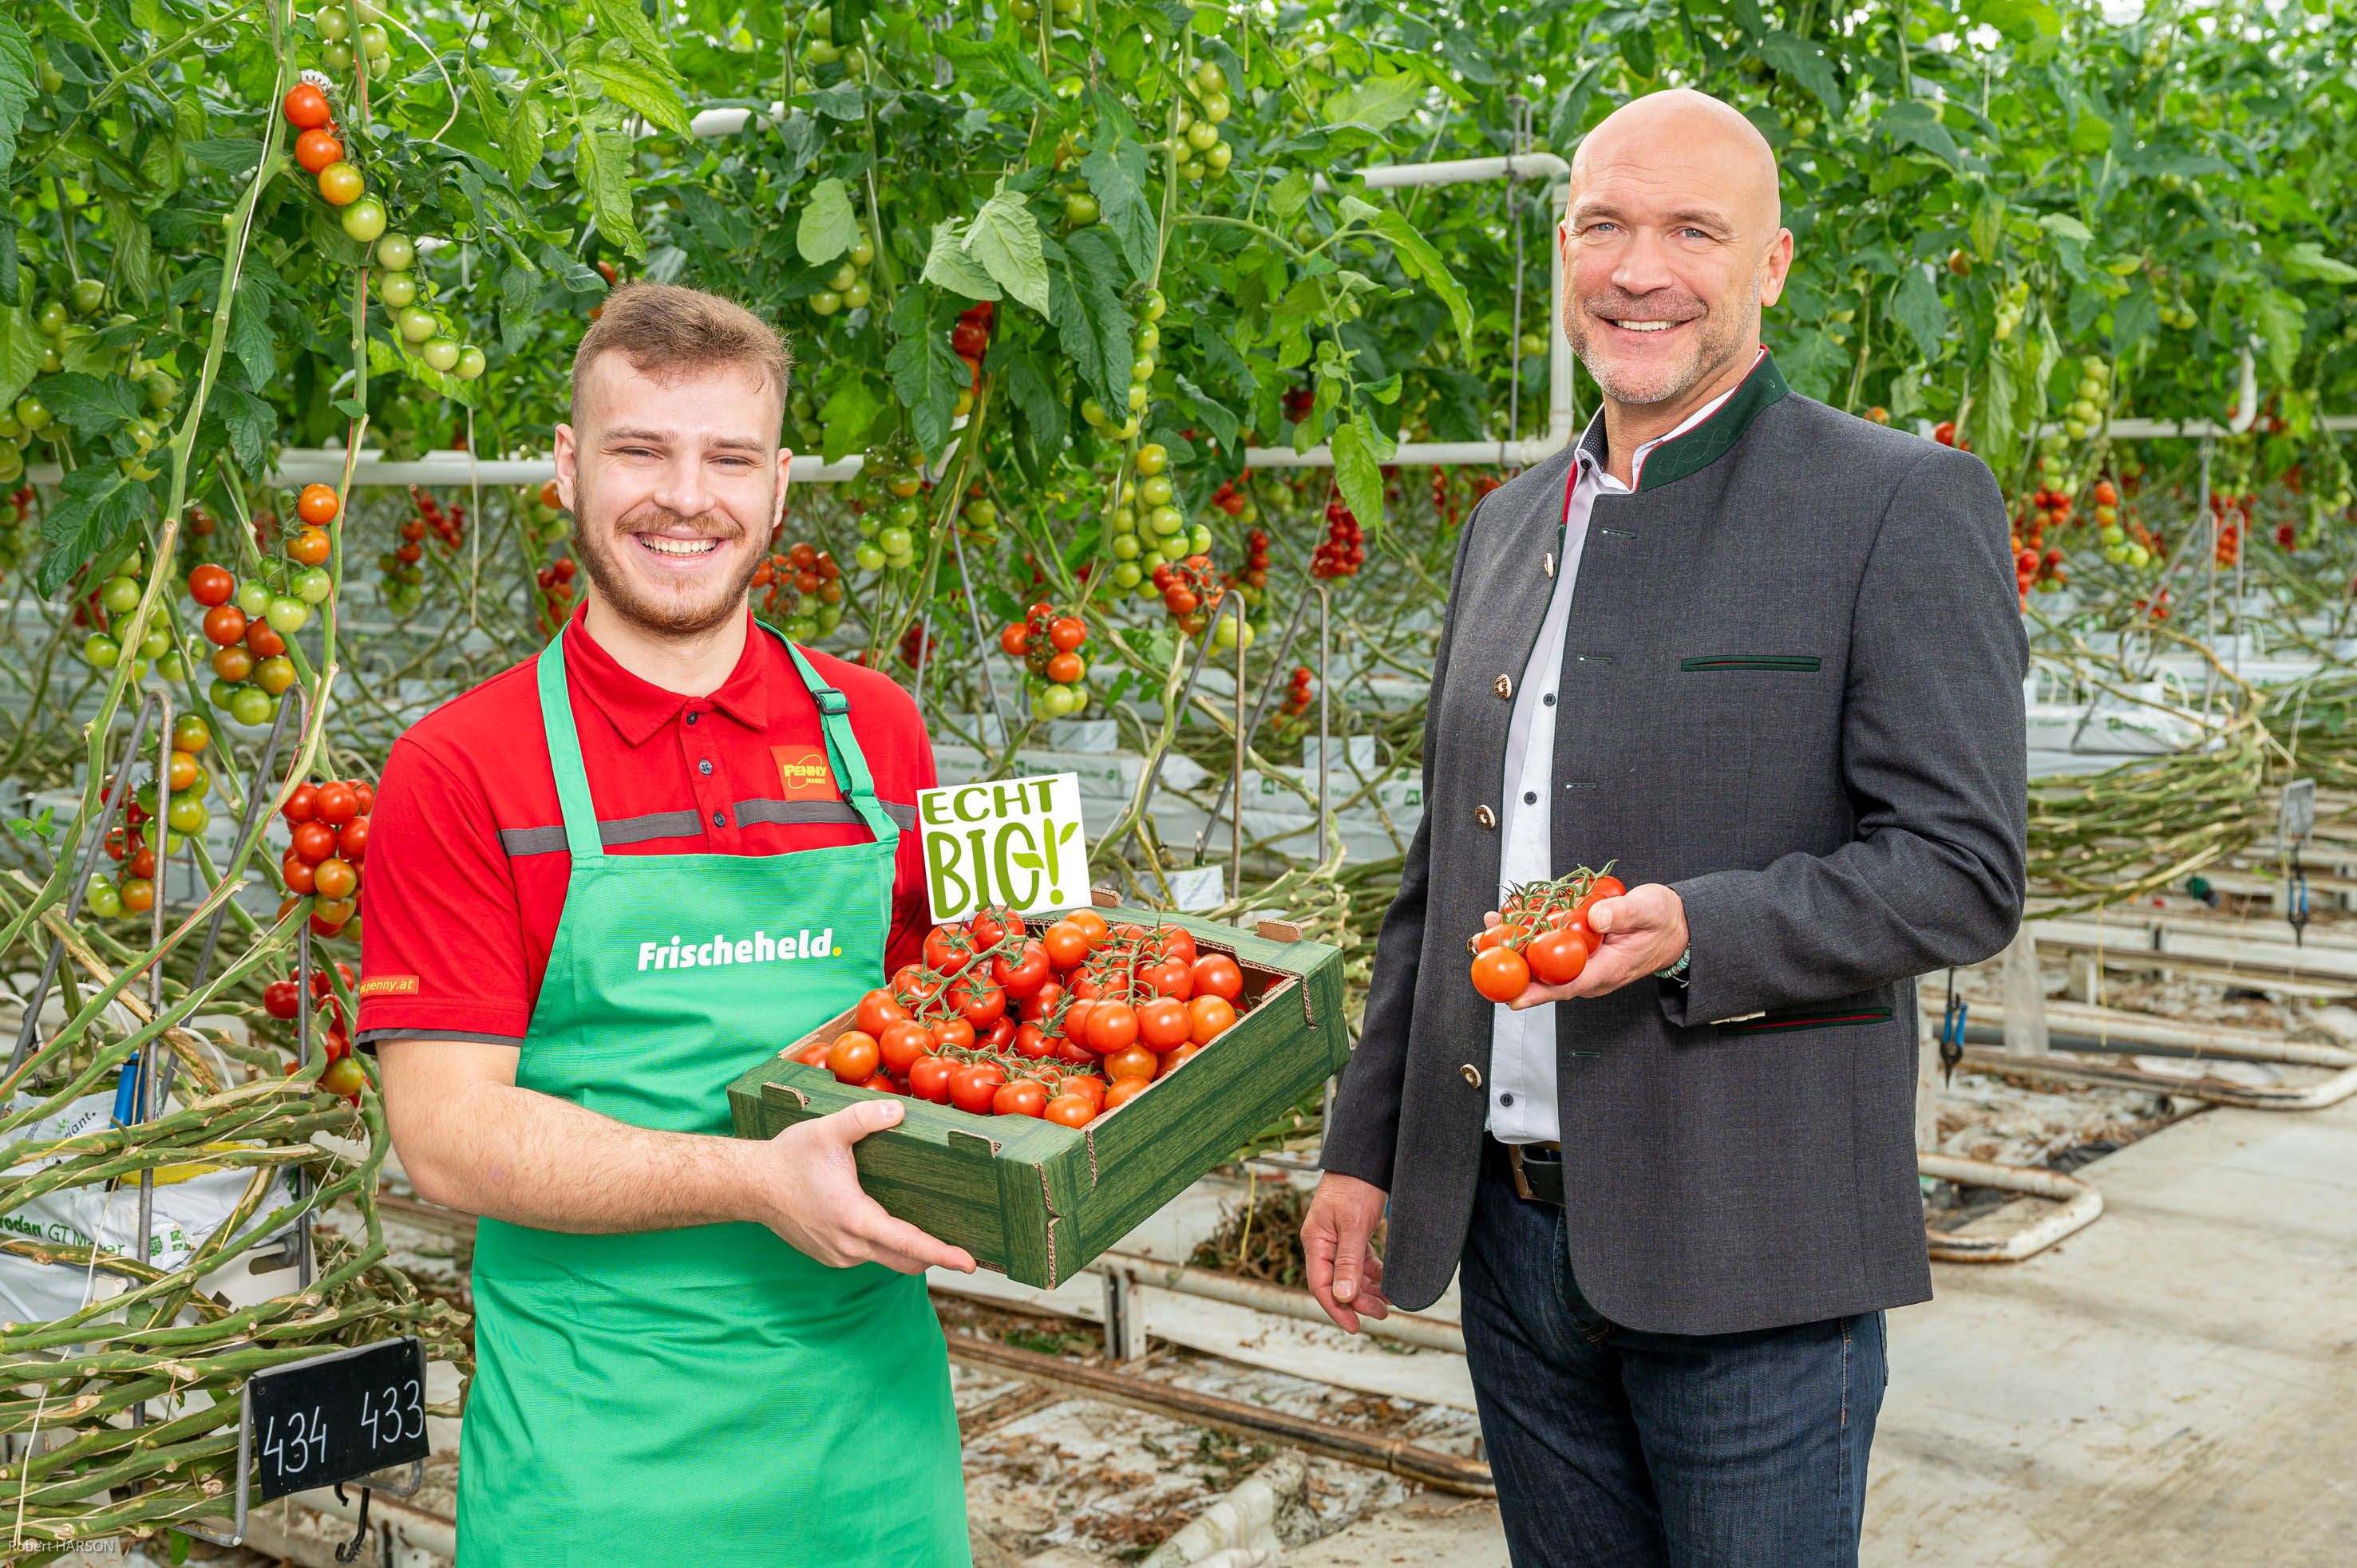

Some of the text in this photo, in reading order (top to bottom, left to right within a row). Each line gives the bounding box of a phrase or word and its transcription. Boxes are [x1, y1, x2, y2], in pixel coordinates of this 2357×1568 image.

[783, 764, 828, 777] PENNY
[922, 778, 1058, 825] ECHT
[637, 927, 842, 971] Frischeheld.
[48, 1223, 69, 1244] GT
[263, 1379, 424, 1476] 434 433
